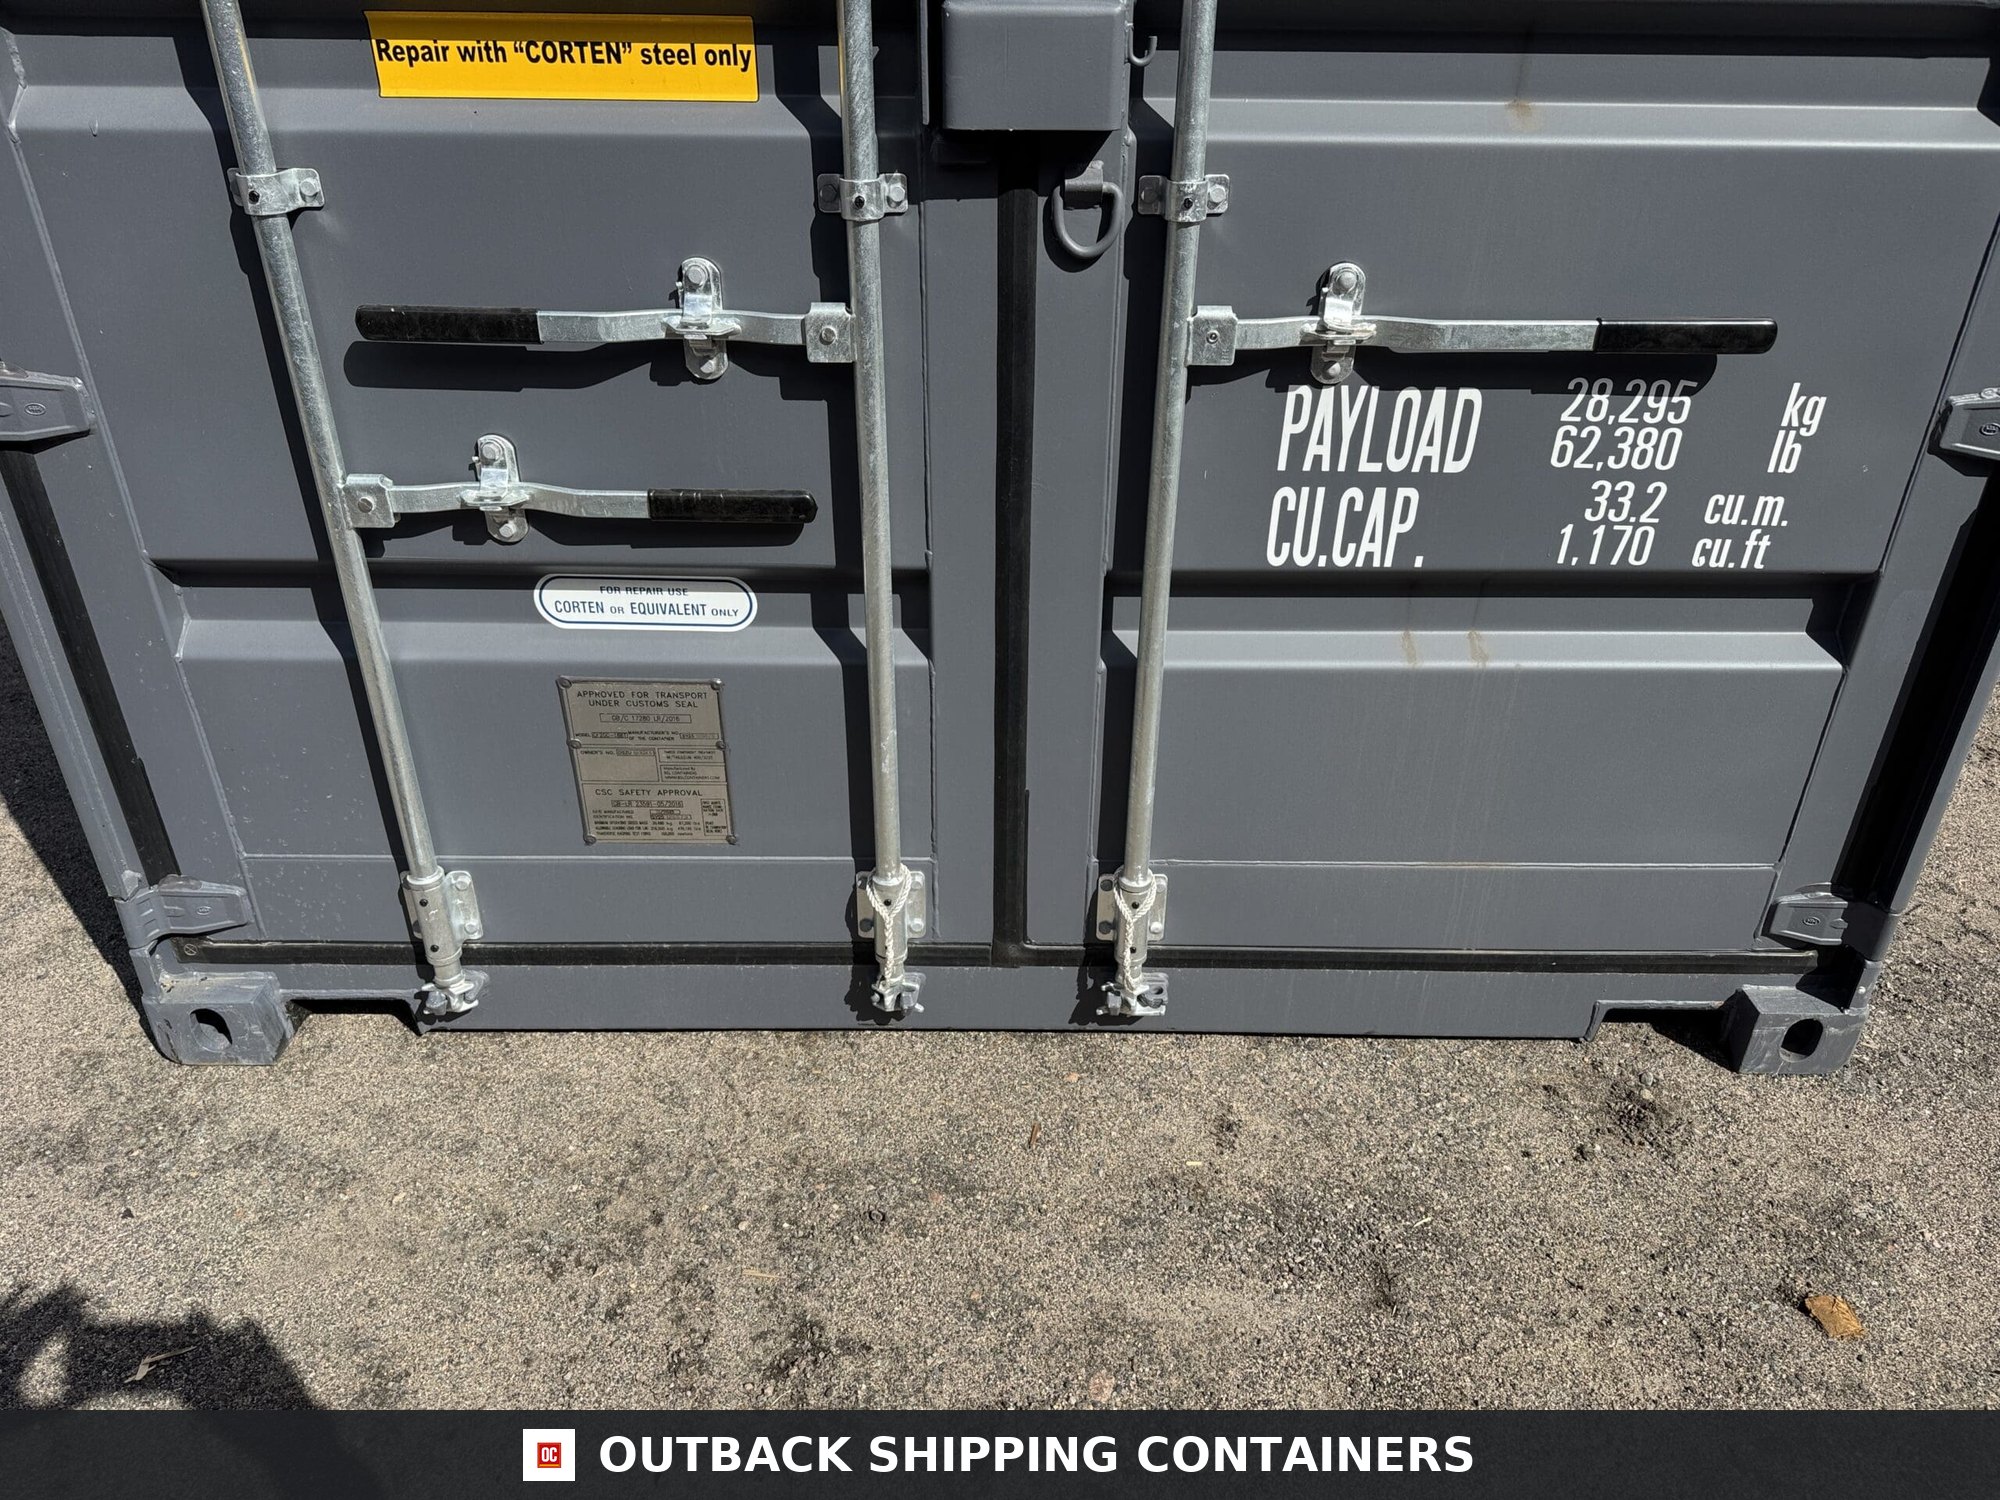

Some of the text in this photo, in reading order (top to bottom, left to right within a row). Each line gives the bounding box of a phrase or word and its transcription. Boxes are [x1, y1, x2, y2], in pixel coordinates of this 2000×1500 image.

[375, 38, 752, 72] Repair with “CORTEN” steel only
[1277, 377, 1826, 474] PAYLOAD 28,295 kg
[1550, 425, 1802, 474] 62,380 lb
[1584, 480, 1668, 523] 33.2
[1703, 492, 1788, 527] cu.m.
[1556, 523, 1771, 569] 1,170 cu.ft
[600, 586, 688, 596] FOR REPAIR USE
[554, 600, 739, 618] CORTEN OR EQUIVALENT ONLY
[577, 691, 708, 700] APPROVED FOR TRANSPORT
[626, 700, 670, 708] CUSTOMS
[675, 700, 698, 708] SEAL
[595, 788, 613, 796] CSC
